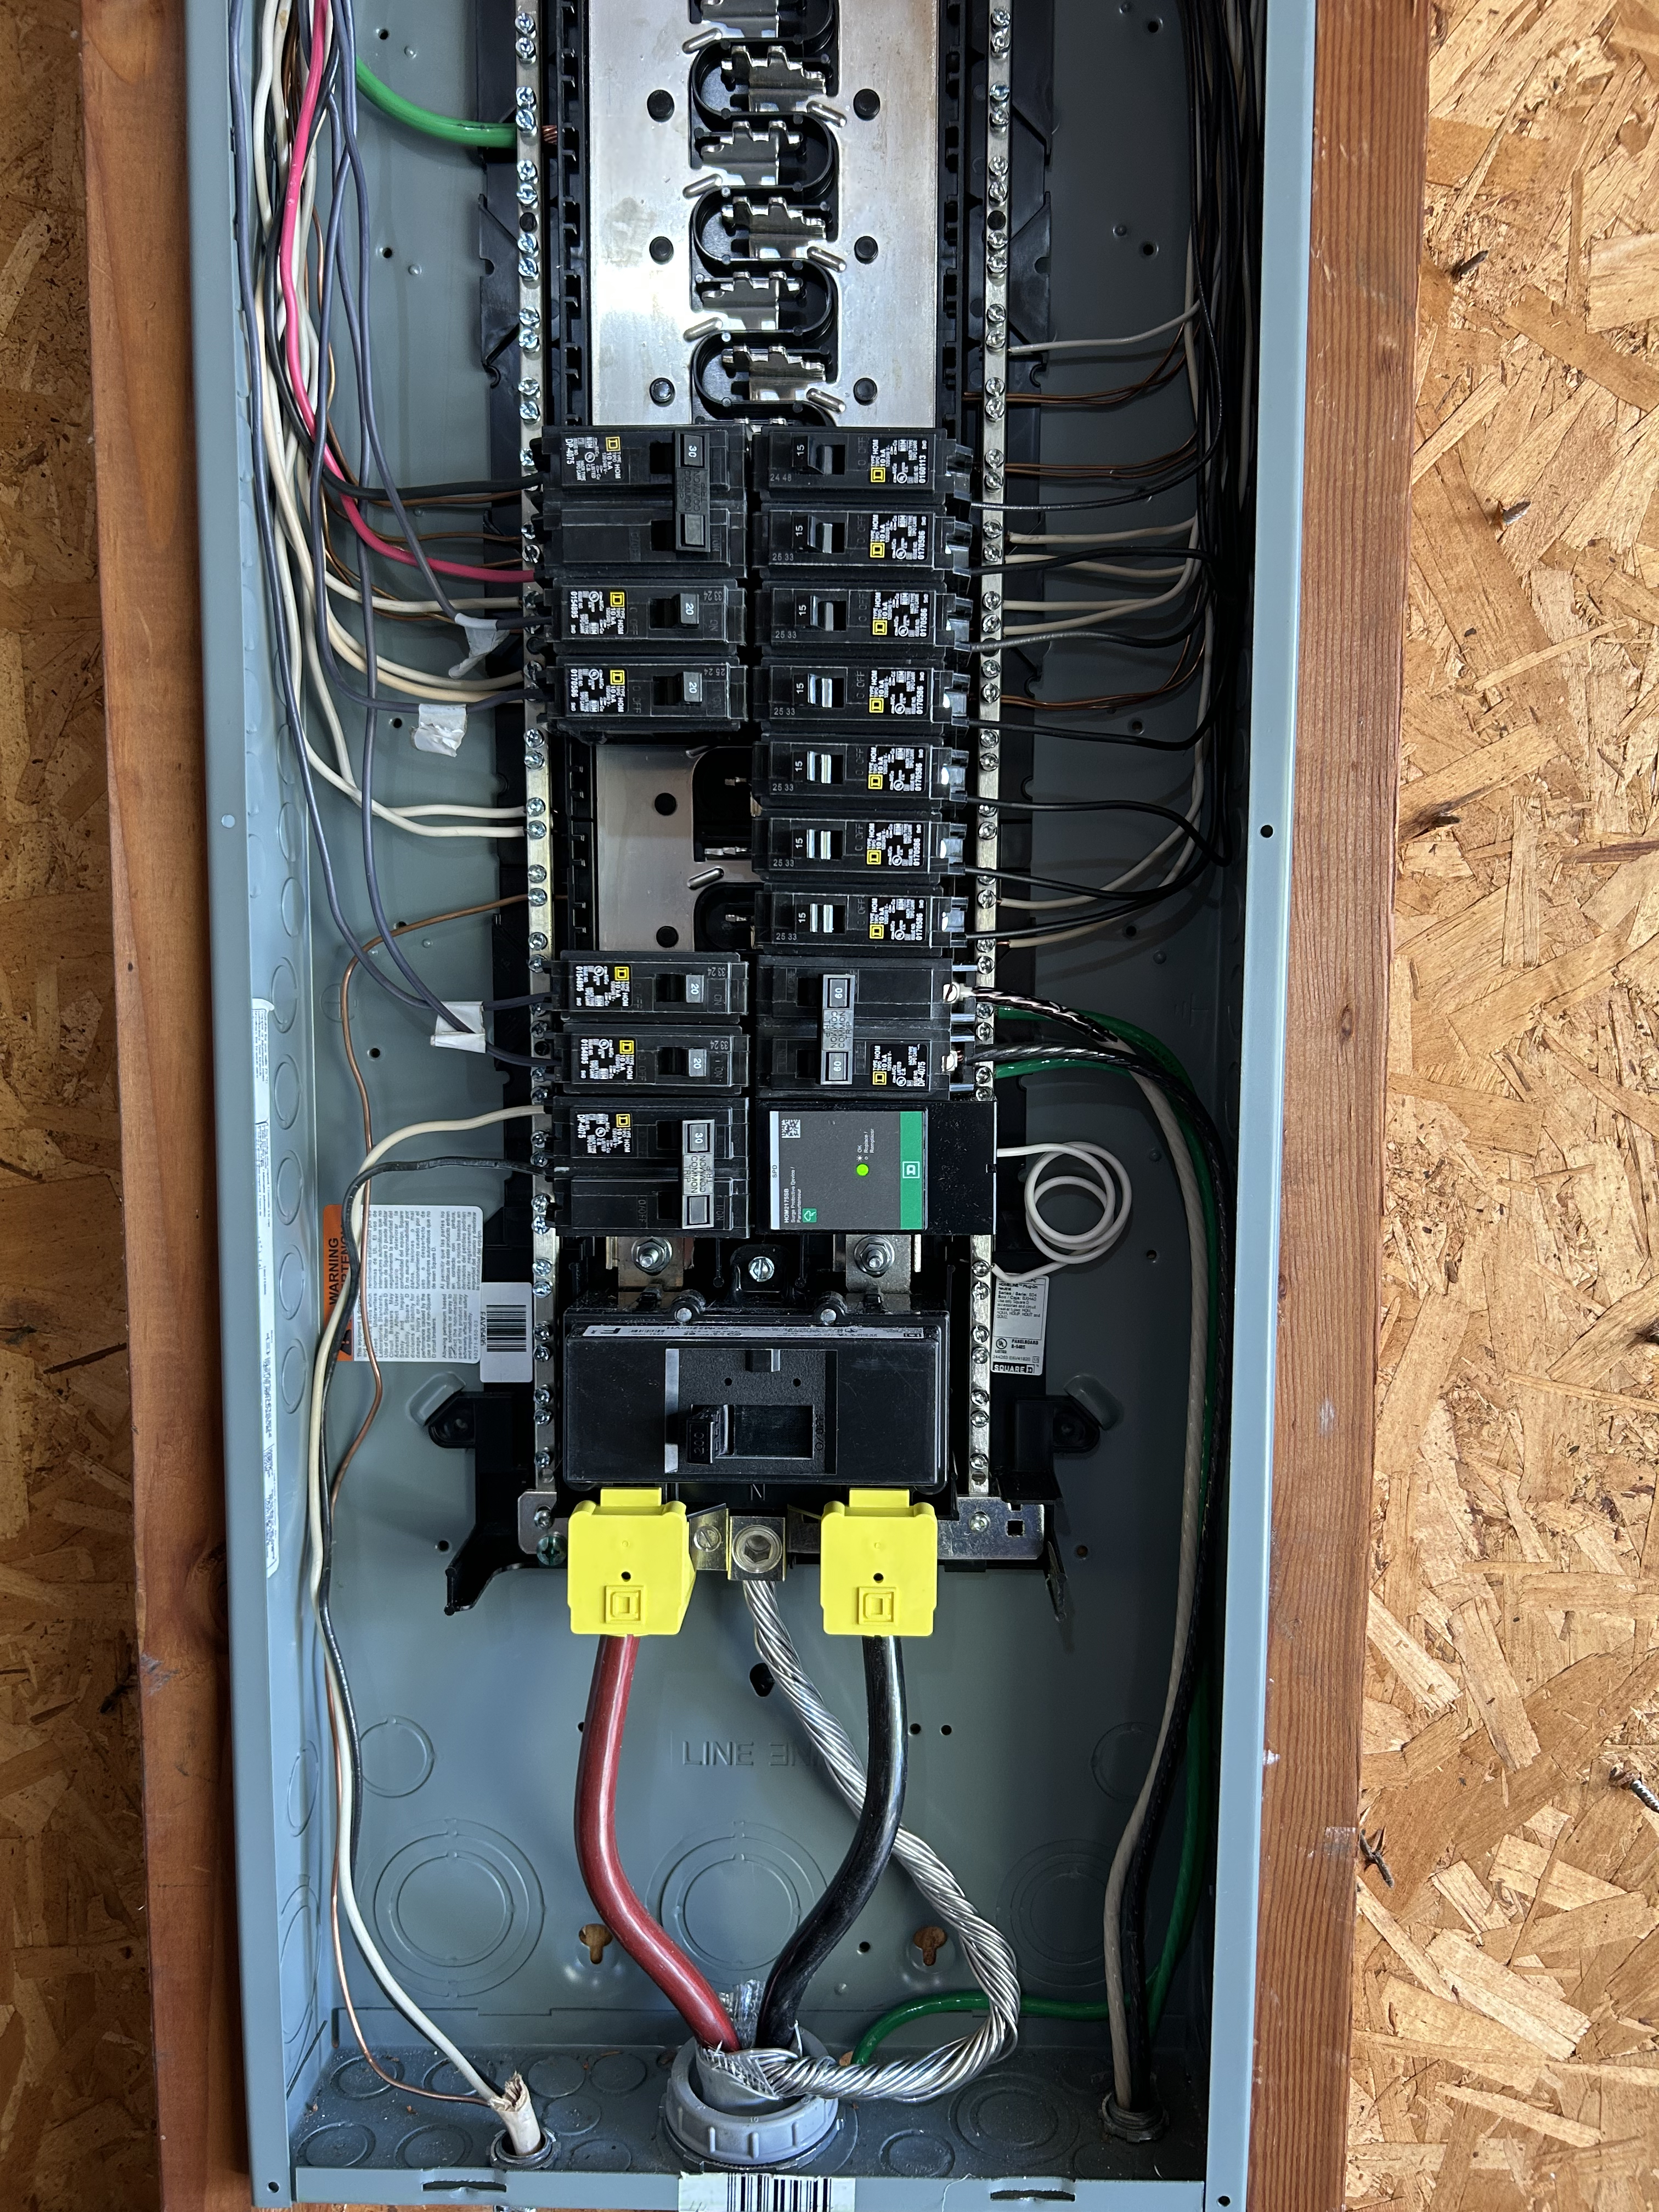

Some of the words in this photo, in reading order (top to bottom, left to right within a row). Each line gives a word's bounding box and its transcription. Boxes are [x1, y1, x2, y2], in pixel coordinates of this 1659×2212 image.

[566, 439, 574, 465] DP-4075
[689, 445, 697, 458] 30
[797, 444, 804, 456] 15
[880, 449, 885, 457] kA
[880, 459, 885, 467] 10
[795, 525, 803, 537] 15
[703, 590, 713, 601] 24
[714, 591, 722, 601] 33
[686, 602, 694, 615] 20
[799, 605, 806, 616] 15
[882, 611, 888, 619] 10
[689, 681, 697, 693] 20
[797, 683, 804, 694] 15
[878, 689, 884, 698] 10
[795, 761, 803, 772] 15
[795, 838, 803, 849] 15
[798, 912, 806, 923] 15
[707, 967, 716, 977] 24
[718, 968, 726, 977] 33
[691, 983, 699, 995] 20
[835, 988, 843, 999] 60
[710, 1040, 719, 1049] 24
[720, 1040, 729, 1049] 33
[693, 1058, 702, 1069] 20
[834, 1061, 842, 1072] 60
[577, 1114, 586, 1138] DP-4075
[695, 1132, 703, 1144] 30
[328, 1238, 340, 1305] WARNING
[994, 1364, 1025, 1373] SQUARE
[815, 1414, 823, 1452] O/OFF
[693, 1432, 704, 1454] 200
[751, 1483, 765, 1500] N
[682, 1741, 754, 1767] LINE
